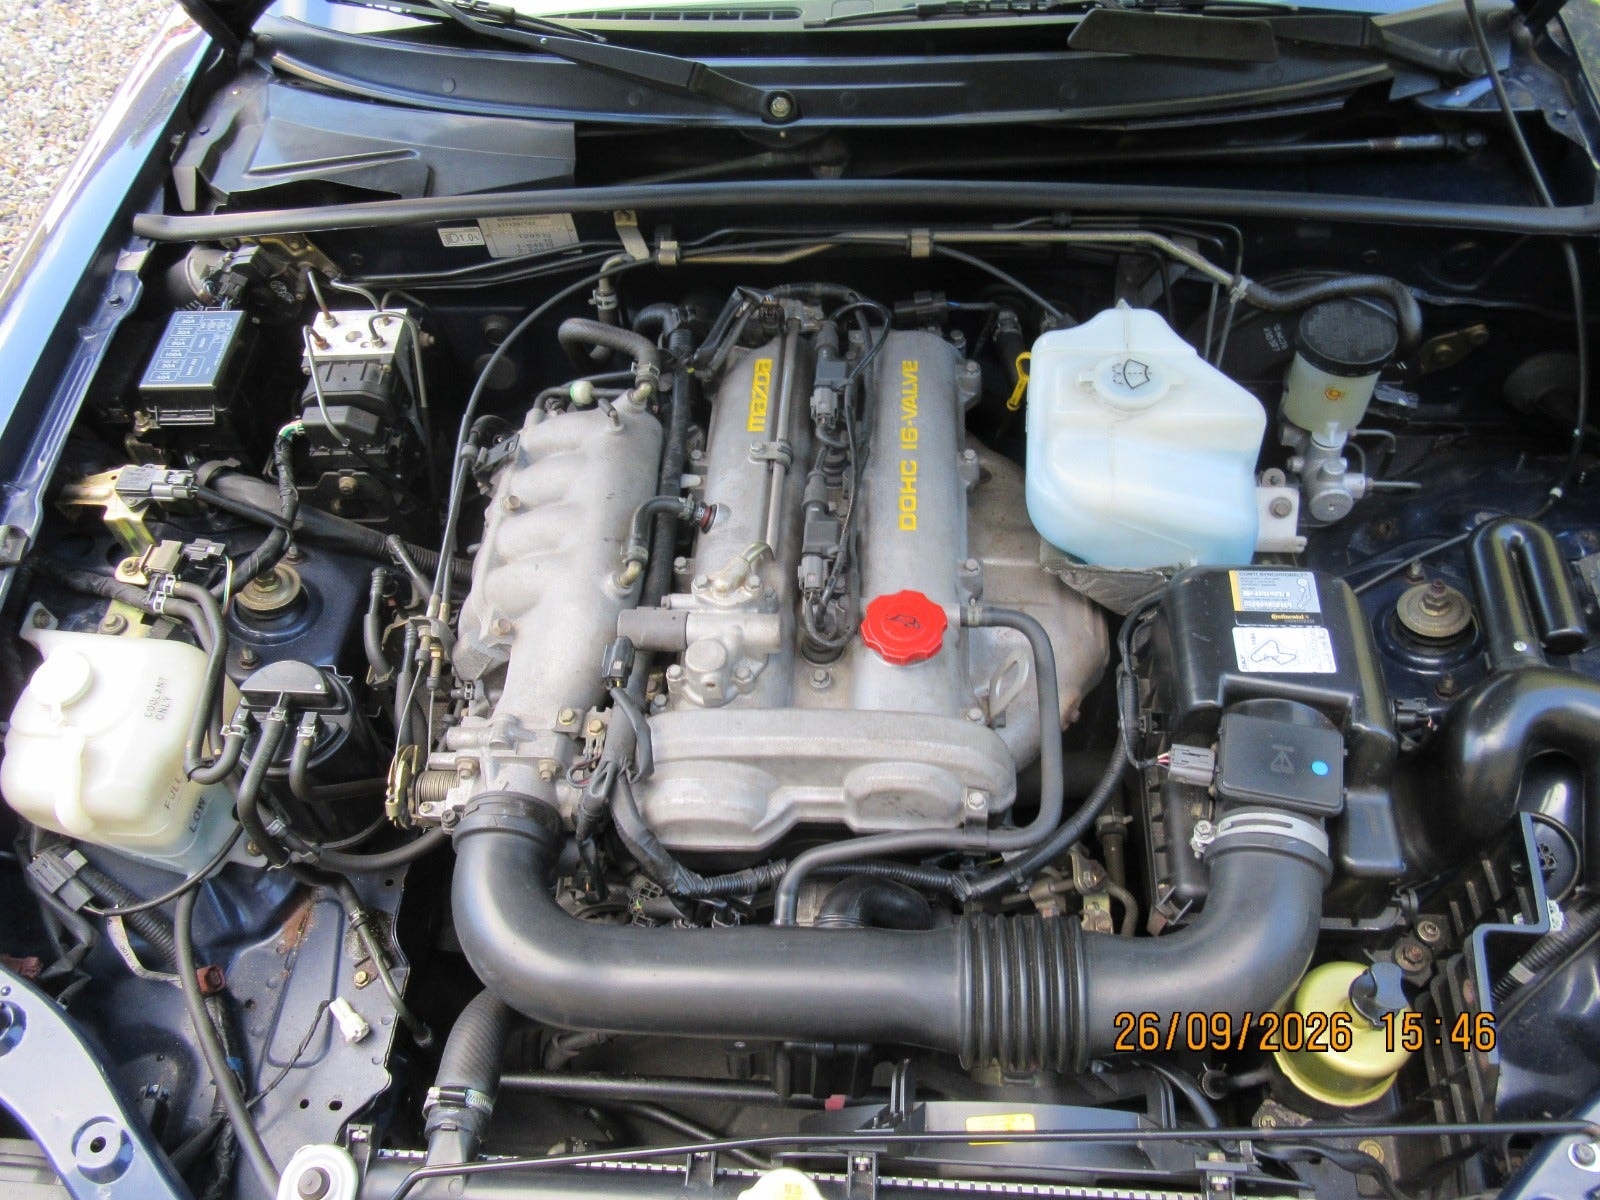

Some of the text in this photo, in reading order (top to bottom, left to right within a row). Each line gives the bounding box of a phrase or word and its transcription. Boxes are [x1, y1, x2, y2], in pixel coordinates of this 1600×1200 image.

[899, 360, 918, 531] DOHC 16-VALVE
[144, 676, 168, 718] COOLANT
[155, 695, 173, 721] ONLY
[163, 777, 183, 810] FULL
[188, 796, 206, 834] LOW
